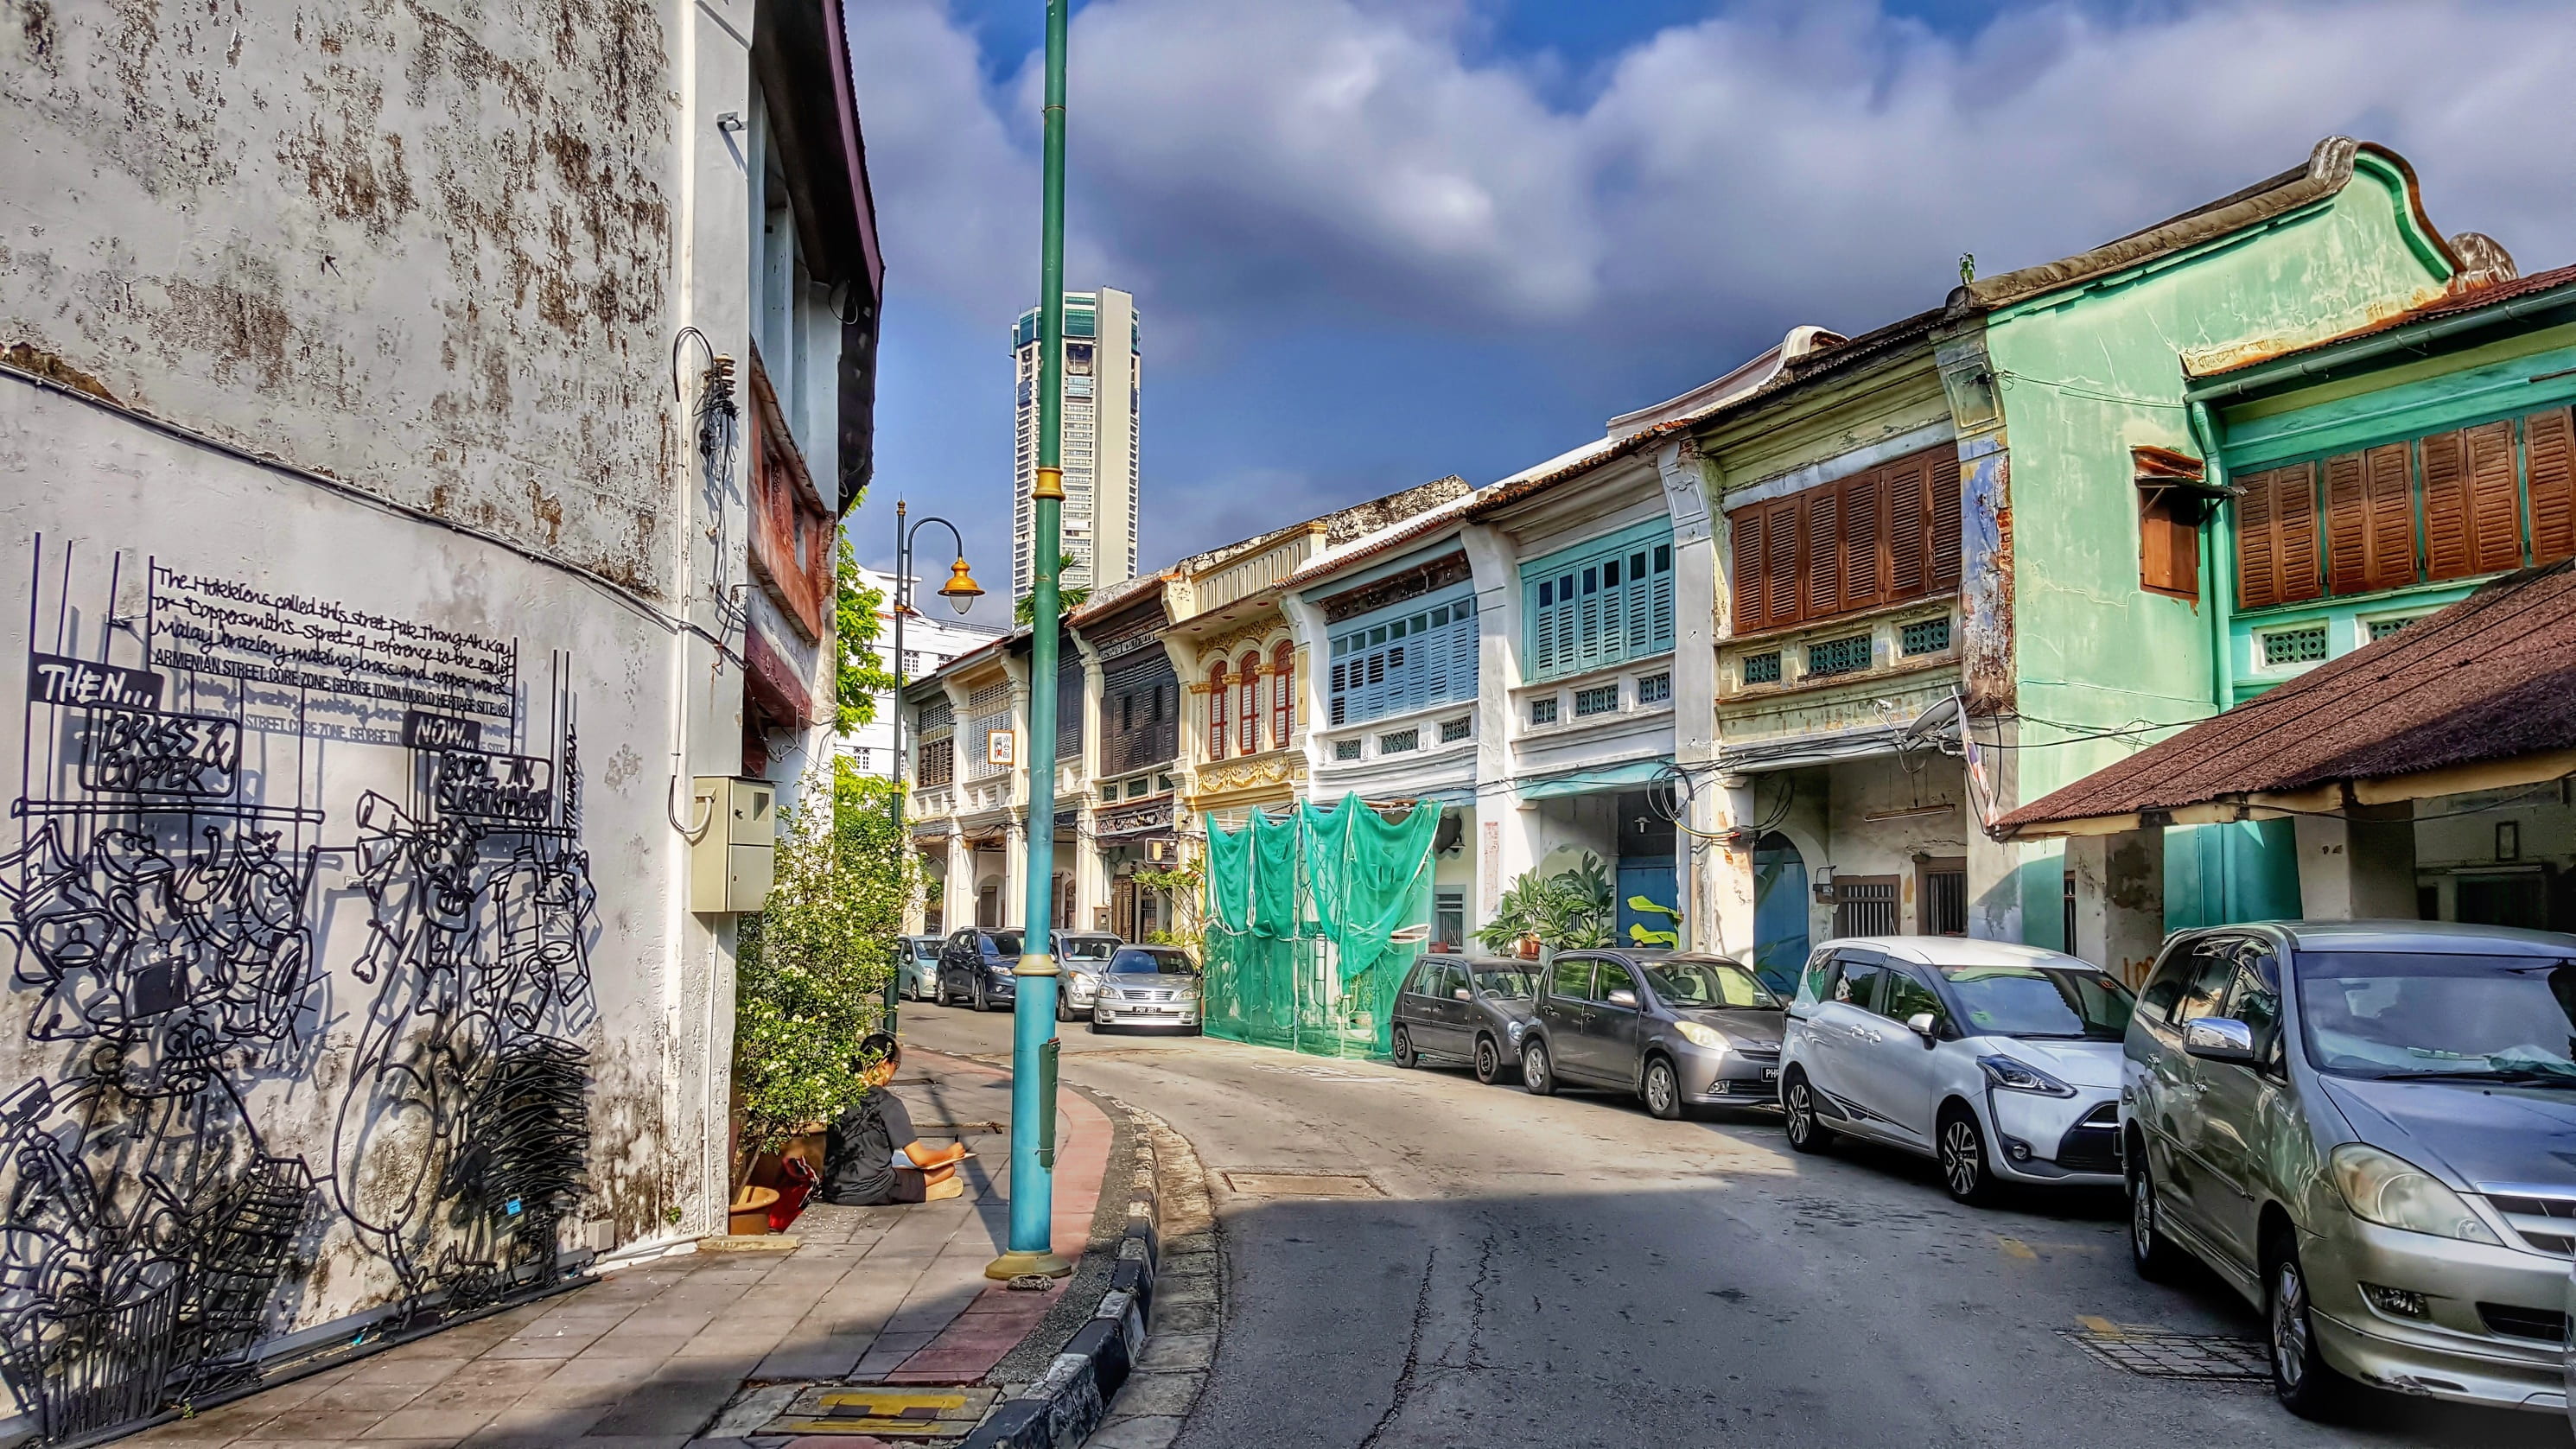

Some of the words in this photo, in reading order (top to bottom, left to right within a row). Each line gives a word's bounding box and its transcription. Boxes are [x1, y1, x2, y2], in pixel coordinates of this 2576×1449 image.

[154, 567, 188, 589] The
[276, 594, 315, 614] called
[319, 601, 347, 622] this
[352, 610, 386, 631] street
[156, 620, 213, 654] Malay
[292, 647, 352, 676] making
[359, 659, 395, 675] brass
[399, 665, 426, 680] and
[373, 637, 432, 660] reference
[436, 648, 448, 664] to
[455, 651, 473, 667] the
[156, 649, 219, 674] ARMENIAN
[270, 668, 298, 685] CORE
[334, 677, 371, 696] GEORGE
[373, 683, 401, 701] TOWN
[402, 687, 436, 706] WORLD
[436, 693, 476, 712] HERITAGE
[477, 701, 496, 715] SITE
[99, 712, 199, 755] BRASS
[202, 721, 234, 775] &
[99, 751, 207, 792] COPPER
